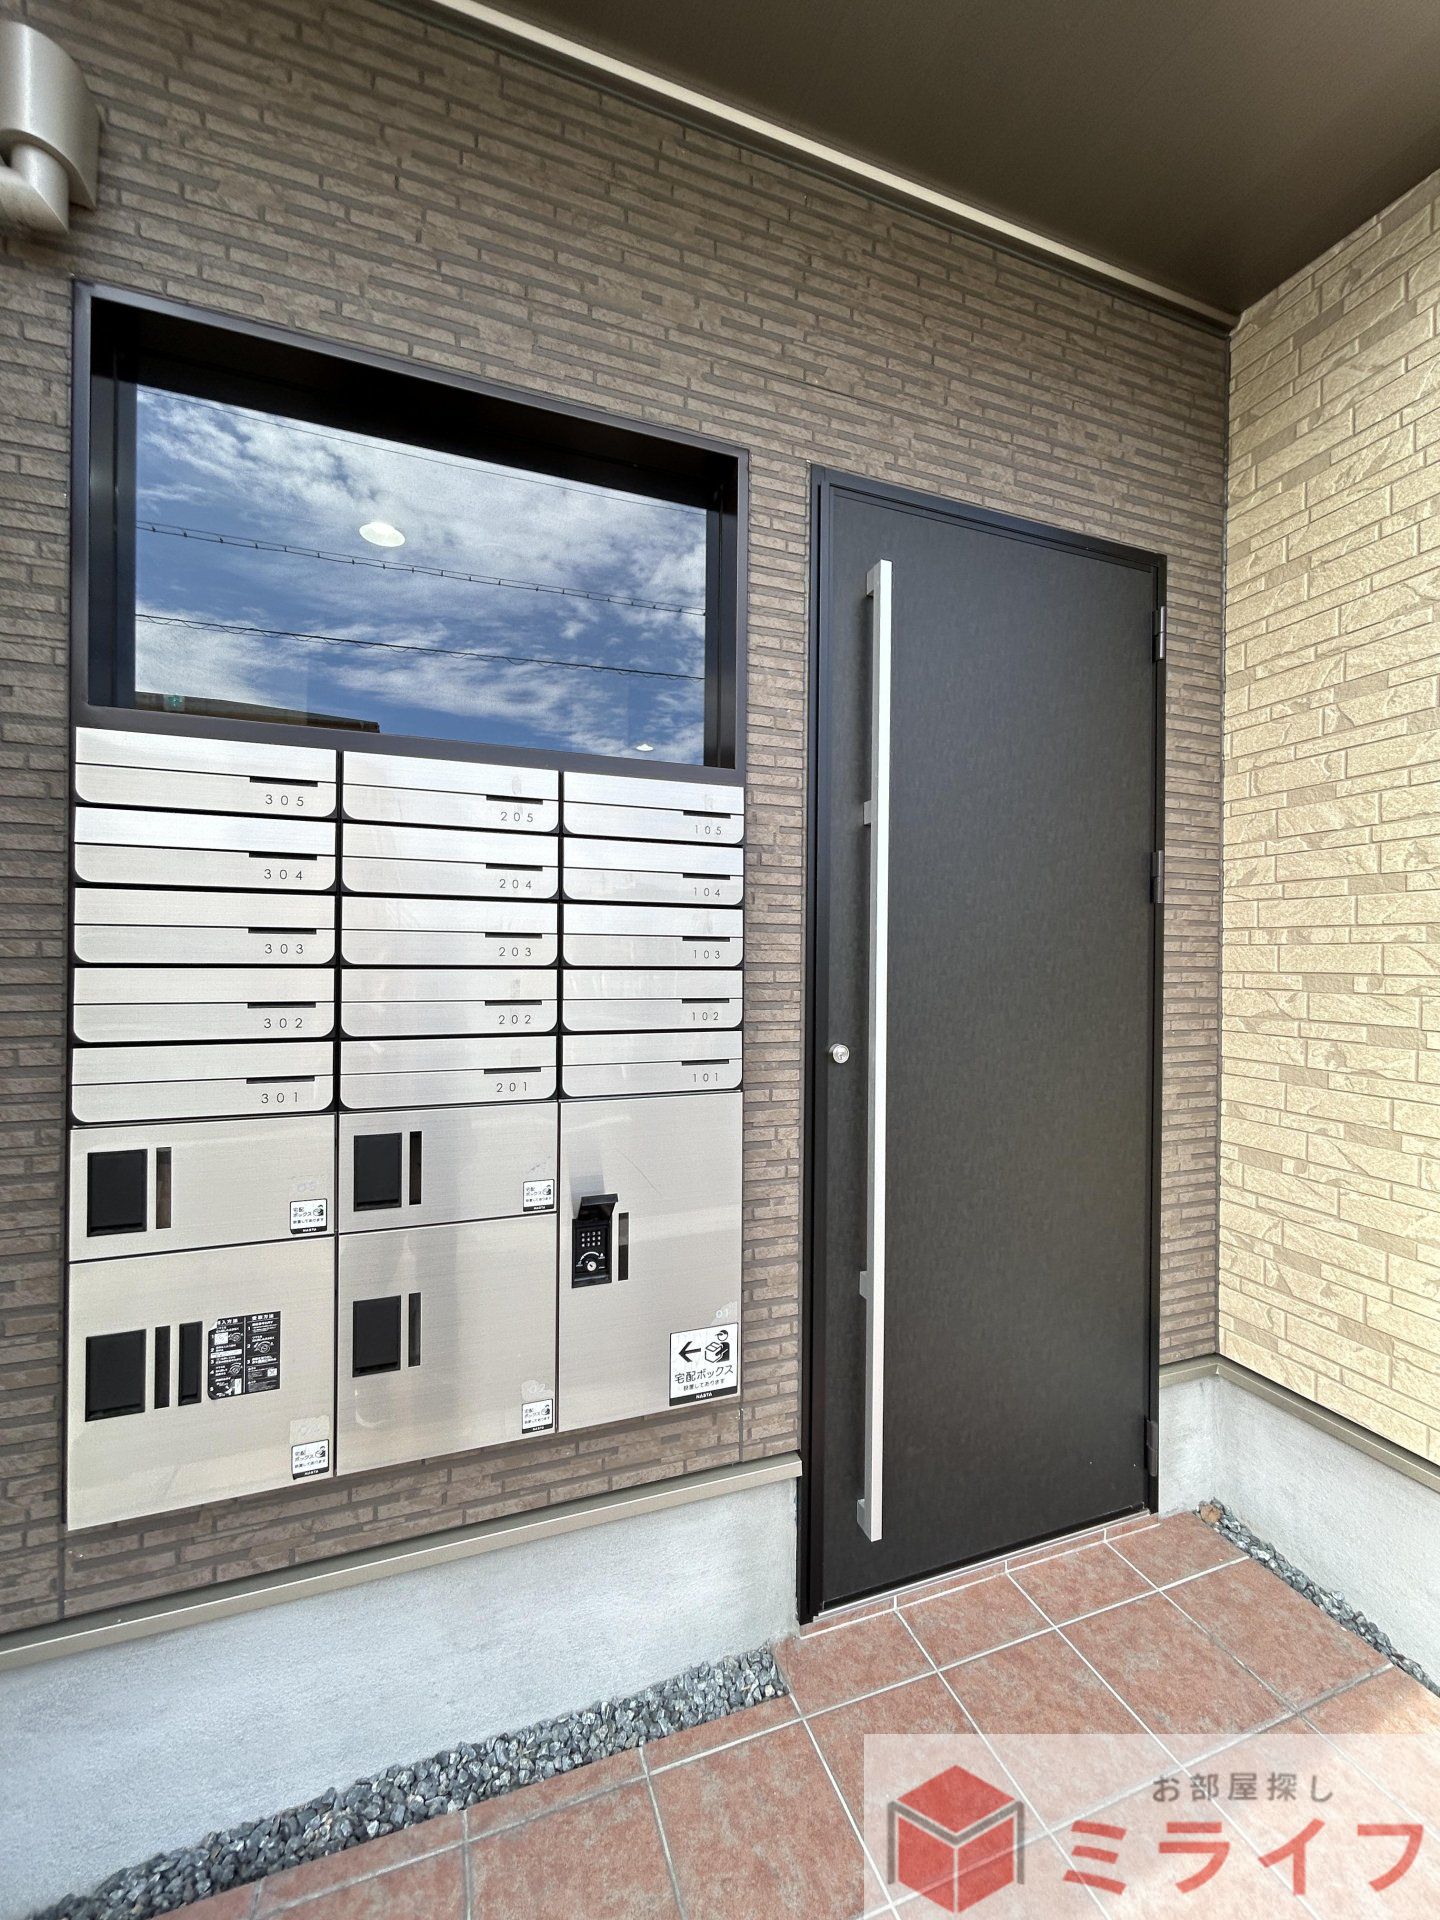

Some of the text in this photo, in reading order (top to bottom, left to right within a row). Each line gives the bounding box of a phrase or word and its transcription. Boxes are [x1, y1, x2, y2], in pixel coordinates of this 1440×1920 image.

[265, 793, 305, 808] 305
[500, 810, 534, 823] 205
[694, 824, 722, 837] 105
[264, 867, 304, 881] 304
[499, 878, 532, 890] 204
[693, 886, 721, 898] 104
[264, 943, 304, 955] 303
[499, 946, 532, 958] 203
[693, 948, 721, 960] 103
[498, 1013, 532, 1025] 202
[692, 1011, 720, 1022] 102
[263, 1017, 303, 1029] 302
[692, 1071, 719, 1083] 101
[496, 1081, 528, 1093] 201
[261, 1091, 299, 1104] 301
[674, 1365, 734, 1384] 宅配ボックス
